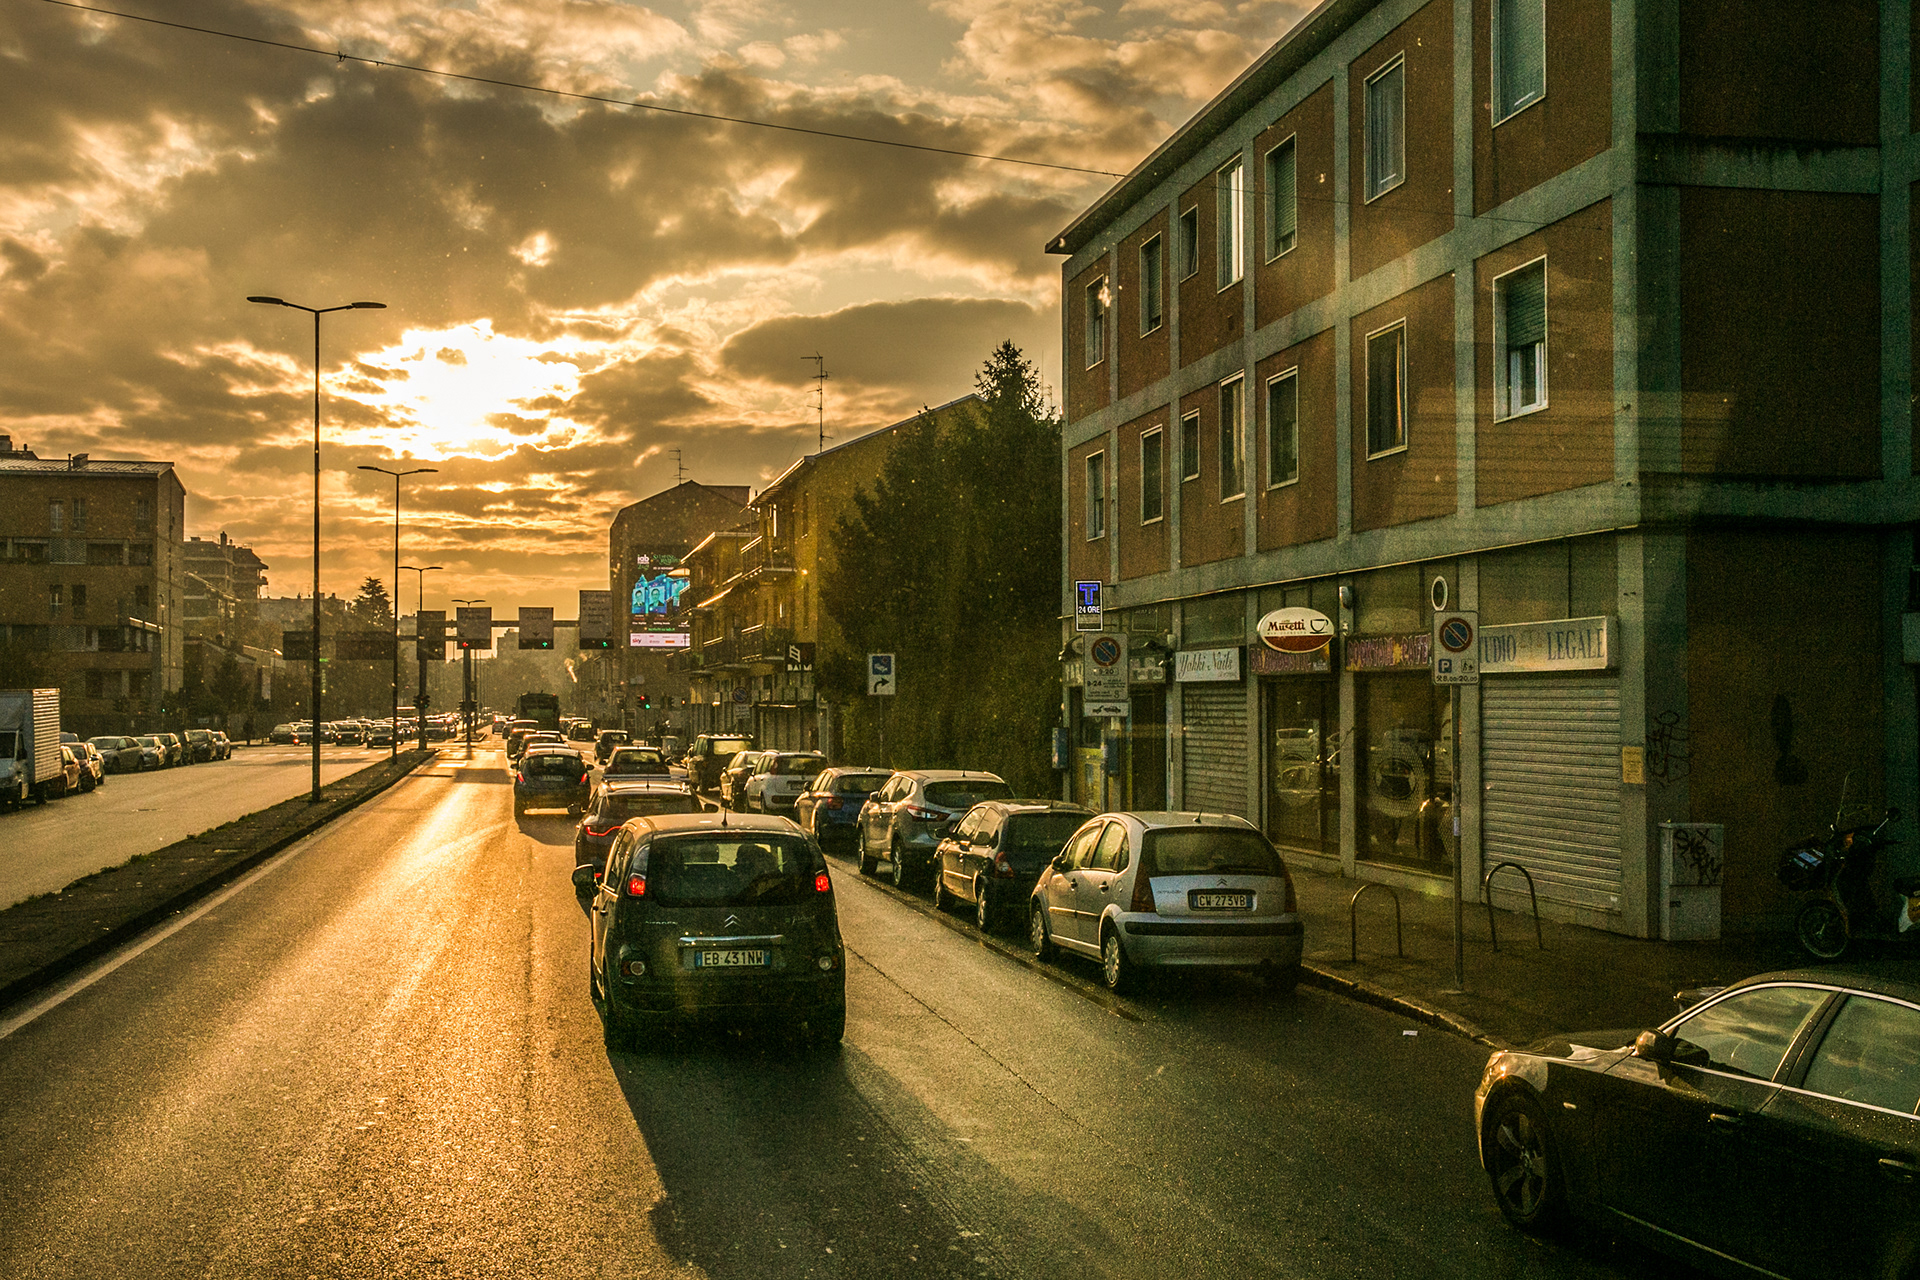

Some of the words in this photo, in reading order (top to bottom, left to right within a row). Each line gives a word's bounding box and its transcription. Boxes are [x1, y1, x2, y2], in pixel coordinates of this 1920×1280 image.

[1078, 583, 1099, 606] T
[1078, 605, 1087, 614] 24
[1087, 605, 1101, 614] ORE
[1267, 618, 1306, 632] Musetti
[1479, 634, 1517, 664] TUDIO
[1546, 627, 1604, 661] LEGALE
[1207, 651, 1233, 671] Nails
[1199, 895, 1211, 906] CW
[1215, 895, 1246, 906] 273VB
[704, 952, 720, 965] EB
[724, 951, 763, 965] 431NW
